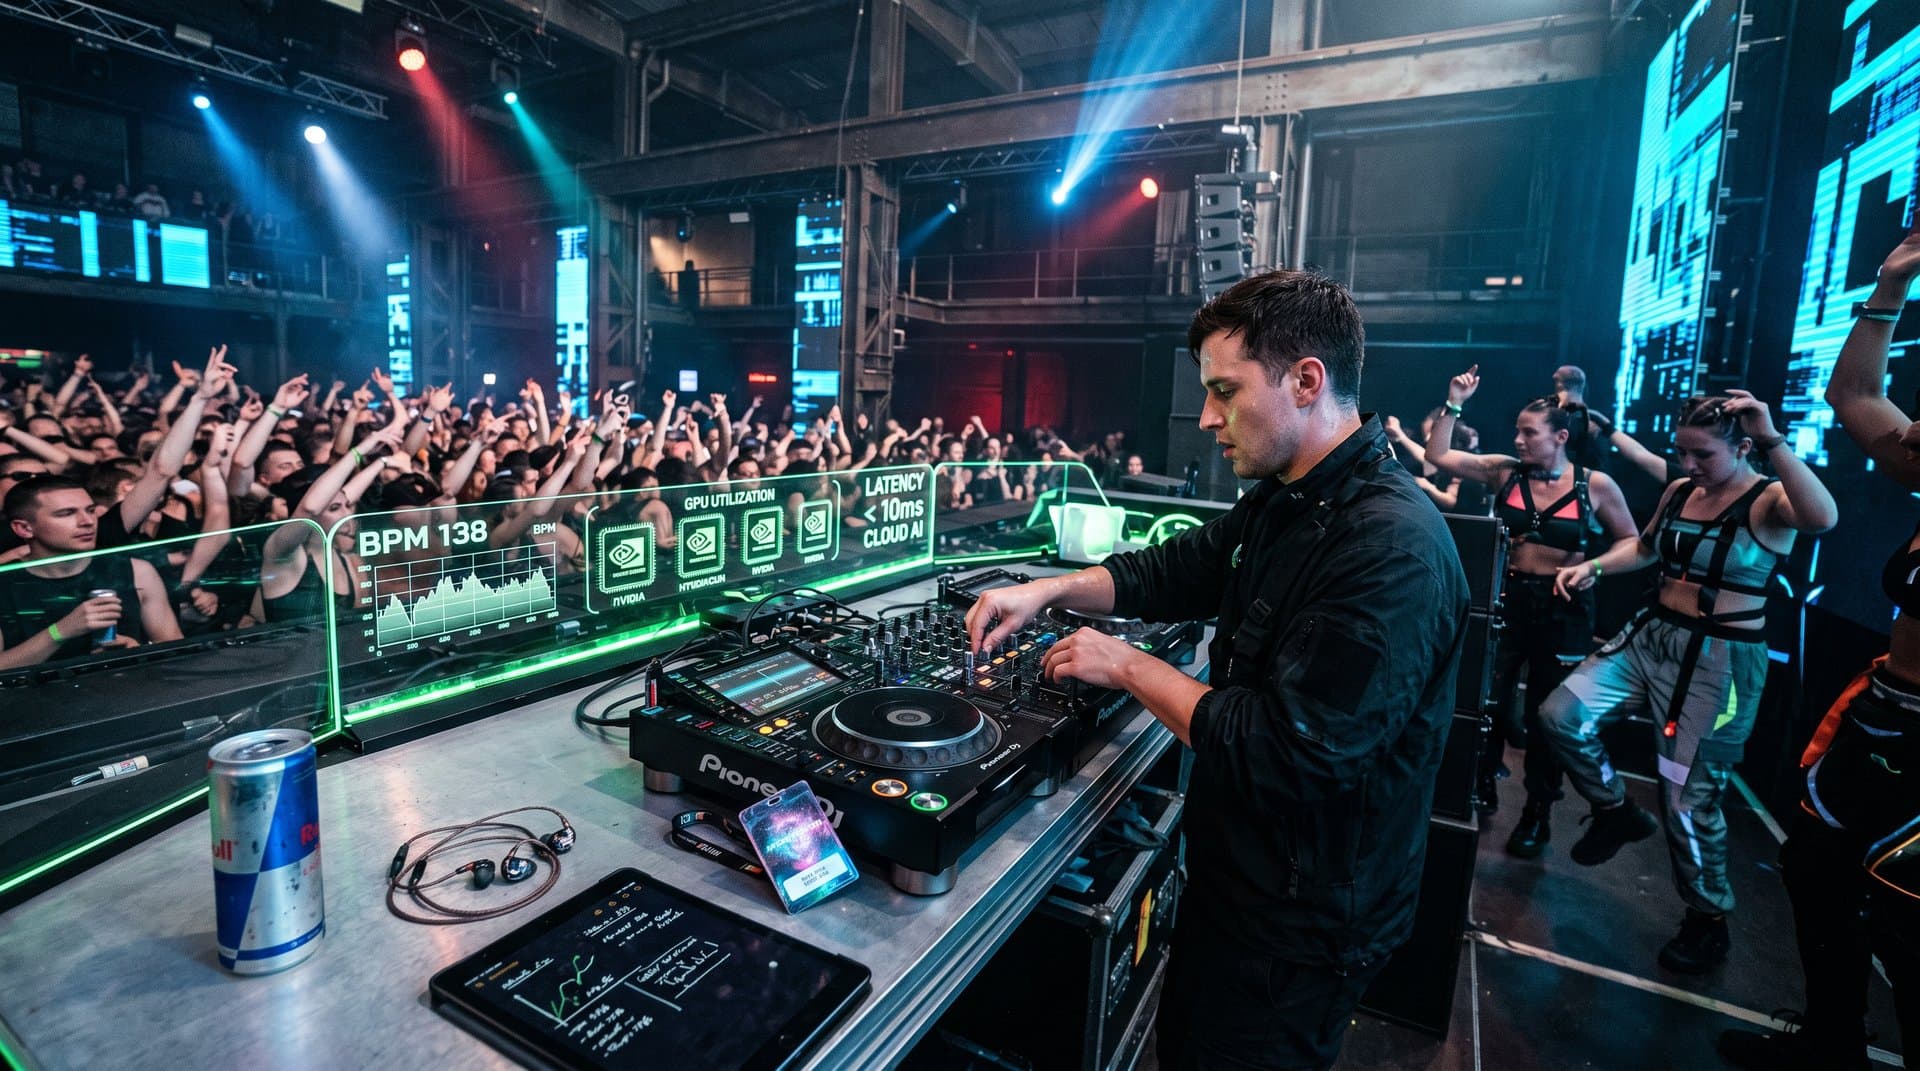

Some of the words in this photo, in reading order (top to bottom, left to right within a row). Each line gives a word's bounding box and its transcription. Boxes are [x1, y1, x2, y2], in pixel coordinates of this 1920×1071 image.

[865, 472, 926, 497] LATENCY
[684, 494, 710, 511] GPU
[711, 488, 776, 509] UTILIZATION
[881, 497, 924, 522] 10ms
[358, 525, 429, 557] BPM
[438, 519, 488, 547] 138
[532, 522, 557, 535] BPM
[863, 523, 908, 549] CLOUD
[910, 519, 924, 540] AI
[698, 752, 778, 798] Pione
[212, 838, 233, 862] ull
